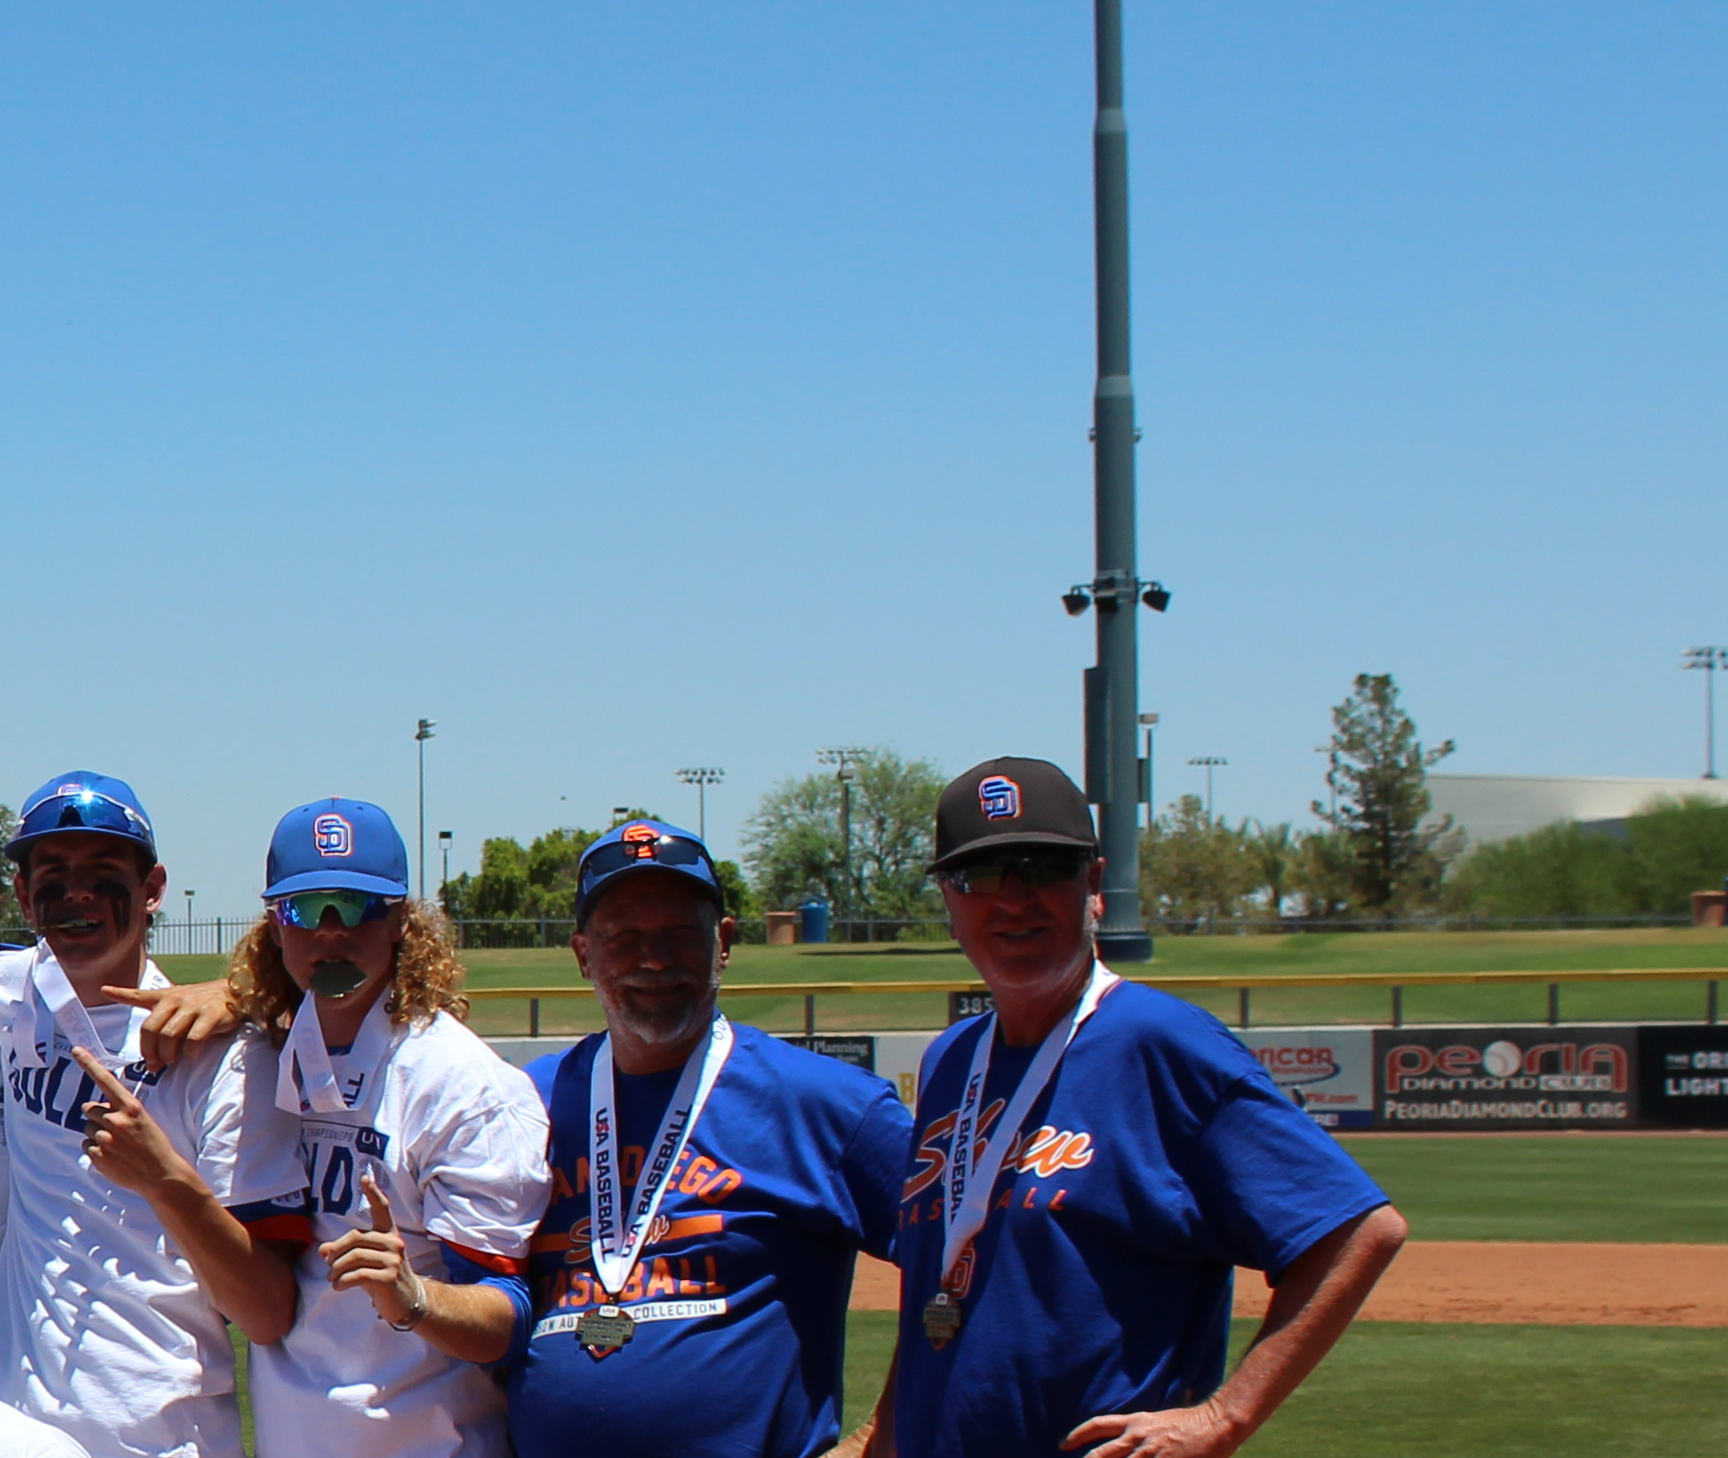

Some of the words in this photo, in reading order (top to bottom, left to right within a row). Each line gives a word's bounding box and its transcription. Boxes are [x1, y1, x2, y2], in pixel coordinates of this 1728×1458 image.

[814, 1041, 869, 1055] Planning
[1252, 1047, 1335, 1065] rican
[962, 1072, 982, 1114] USA
[595, 1107, 611, 1147] USA
[621, 1145, 744, 1206] DEGO
[638, 1103, 694, 1224] BASEBALL
[951, 1115, 972, 1226] BASEBA
[595, 1149, 616, 1264] BASEBALL
[633, 1301, 718, 1321] COLLECTION
